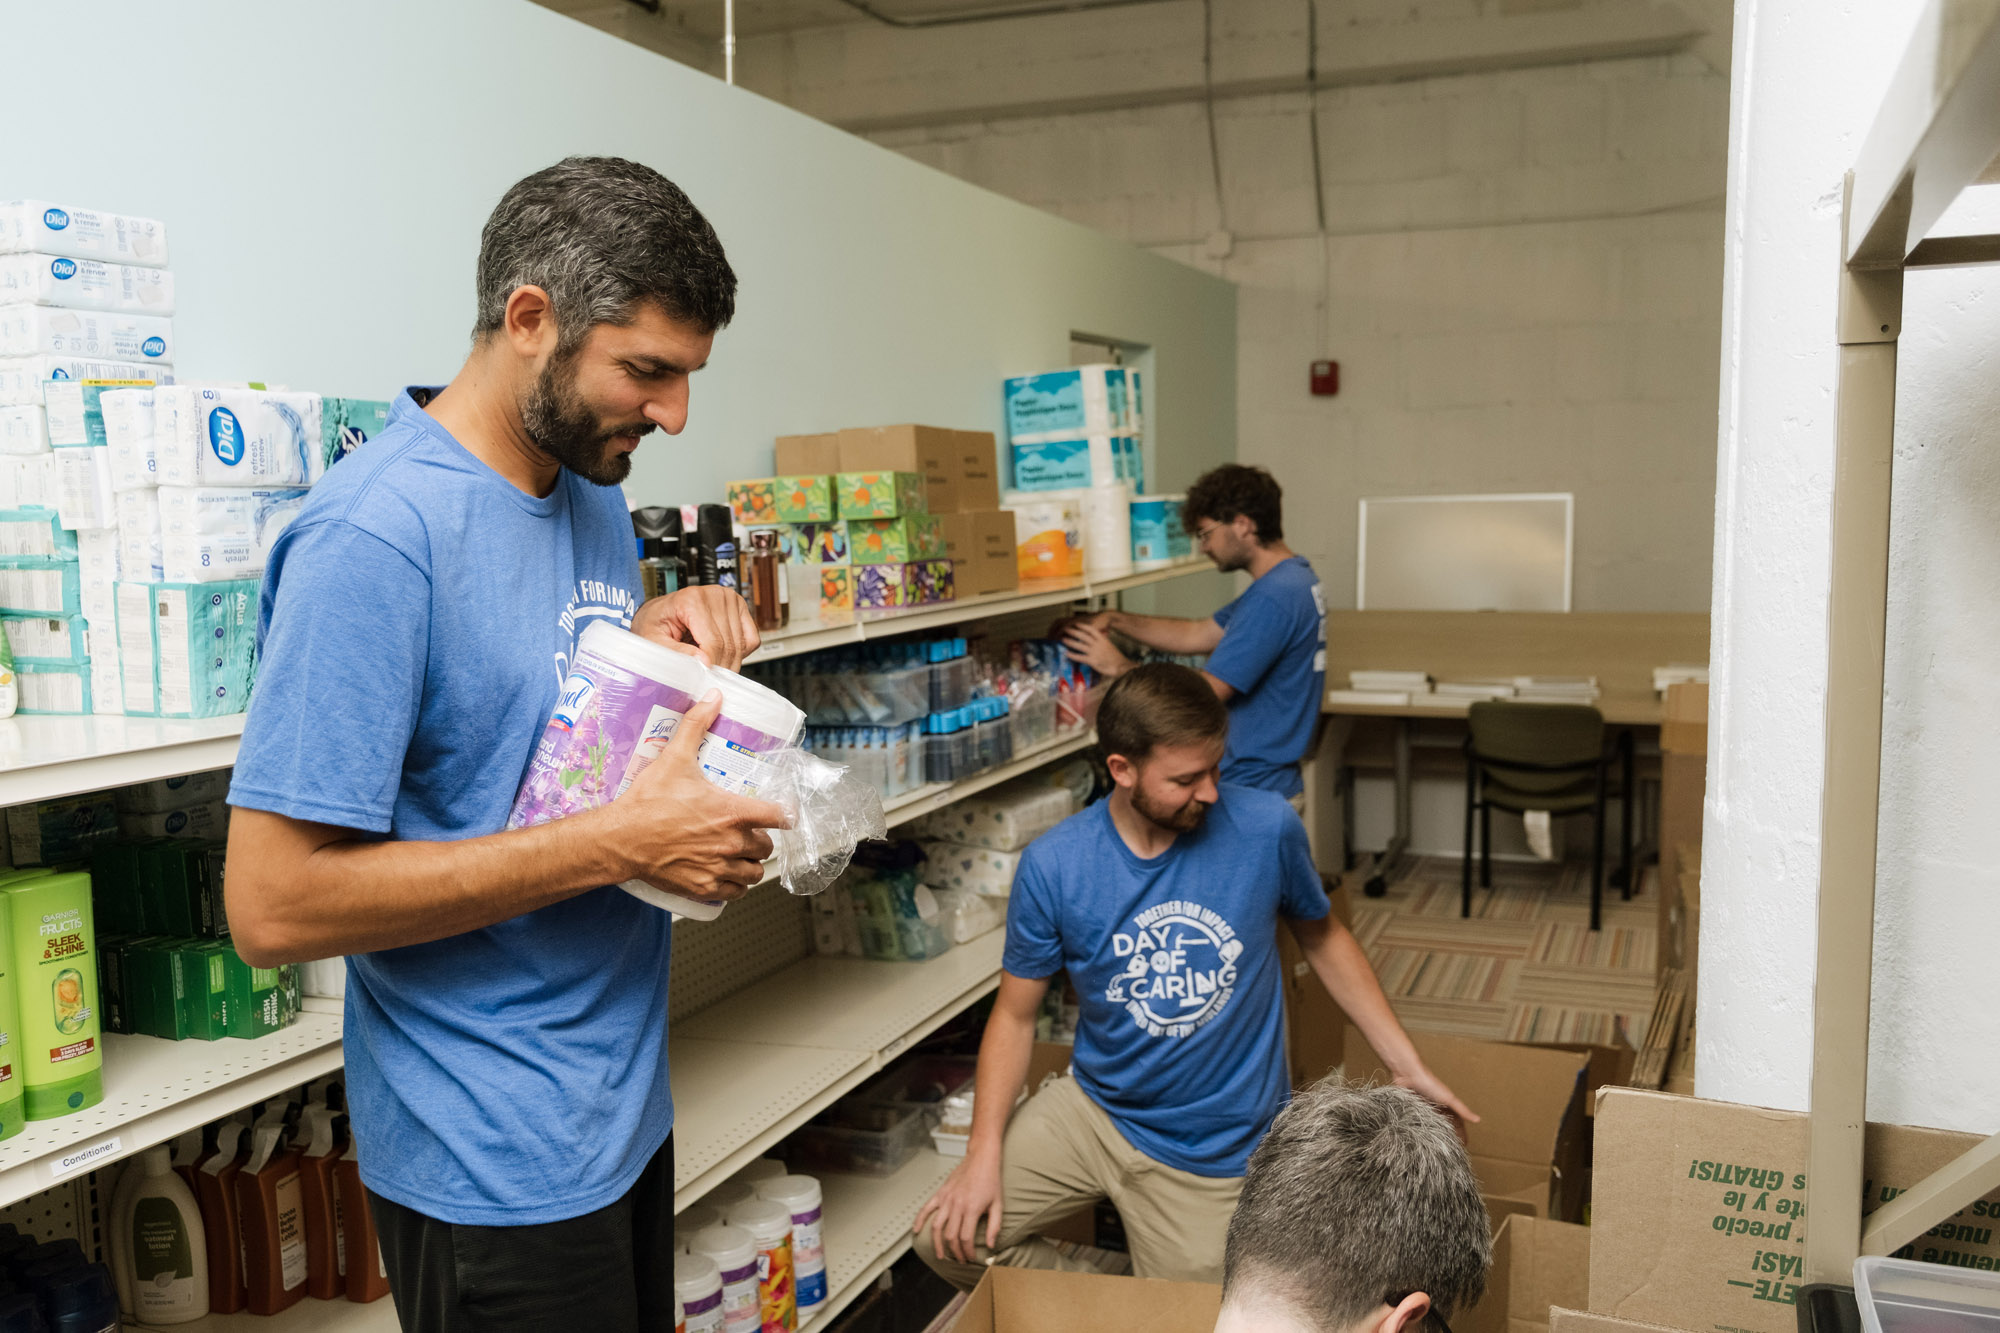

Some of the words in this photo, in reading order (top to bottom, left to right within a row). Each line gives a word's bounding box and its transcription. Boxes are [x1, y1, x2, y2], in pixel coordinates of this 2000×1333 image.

[46, 212, 67, 226] Dial
[53, 264, 75, 275] Dial
[144, 341, 164, 353] Dial
[202, 390, 214, 400] 8
[216, 411, 235, 462] Dial
[250, 441, 258, 475] refresh
[201, 553, 211, 566] 8
[225, 555, 249, 563] refresh
[580, 580, 606, 602] FOR
[236, 592, 247, 626] Aqua
[650, 720, 676, 736] Lysol
[42, 909, 79, 923] GARNIER
[1134, 900, 1182, 929] TOGETHER
[1182, 901, 1202, 919] FOR
[1200, 907, 1236, 941] IMPACT
[39, 918, 82, 936] FRUCTIS
[47, 932, 81, 948] SLEEK
[1112, 925, 1171, 957] DAY
[43, 949, 52, 959] &
[54, 941, 85, 956] SHINE
[1150, 950, 1187, 974] OF
[1130, 964, 1237, 1007] CARING
[263, 998, 271, 1025] IRISH
[270, 992, 278, 1026] SPRING
[63, 1142, 114, 1166] Conditioner
[1688, 1160, 1785, 1190] GRATIS!
[1723, 1191, 1747, 1212] le
[1752, 1191, 1770, 1211] y
[279, 1208, 296, 1219] Cocoa
[280, 1214, 297, 1226] Butter
[280, 1224, 294, 1234] Body
[281, 1230, 298, 1241] Lotion
[1712, 1215, 1792, 1241] precio
[144, 1233, 174, 1243] oatmeal
